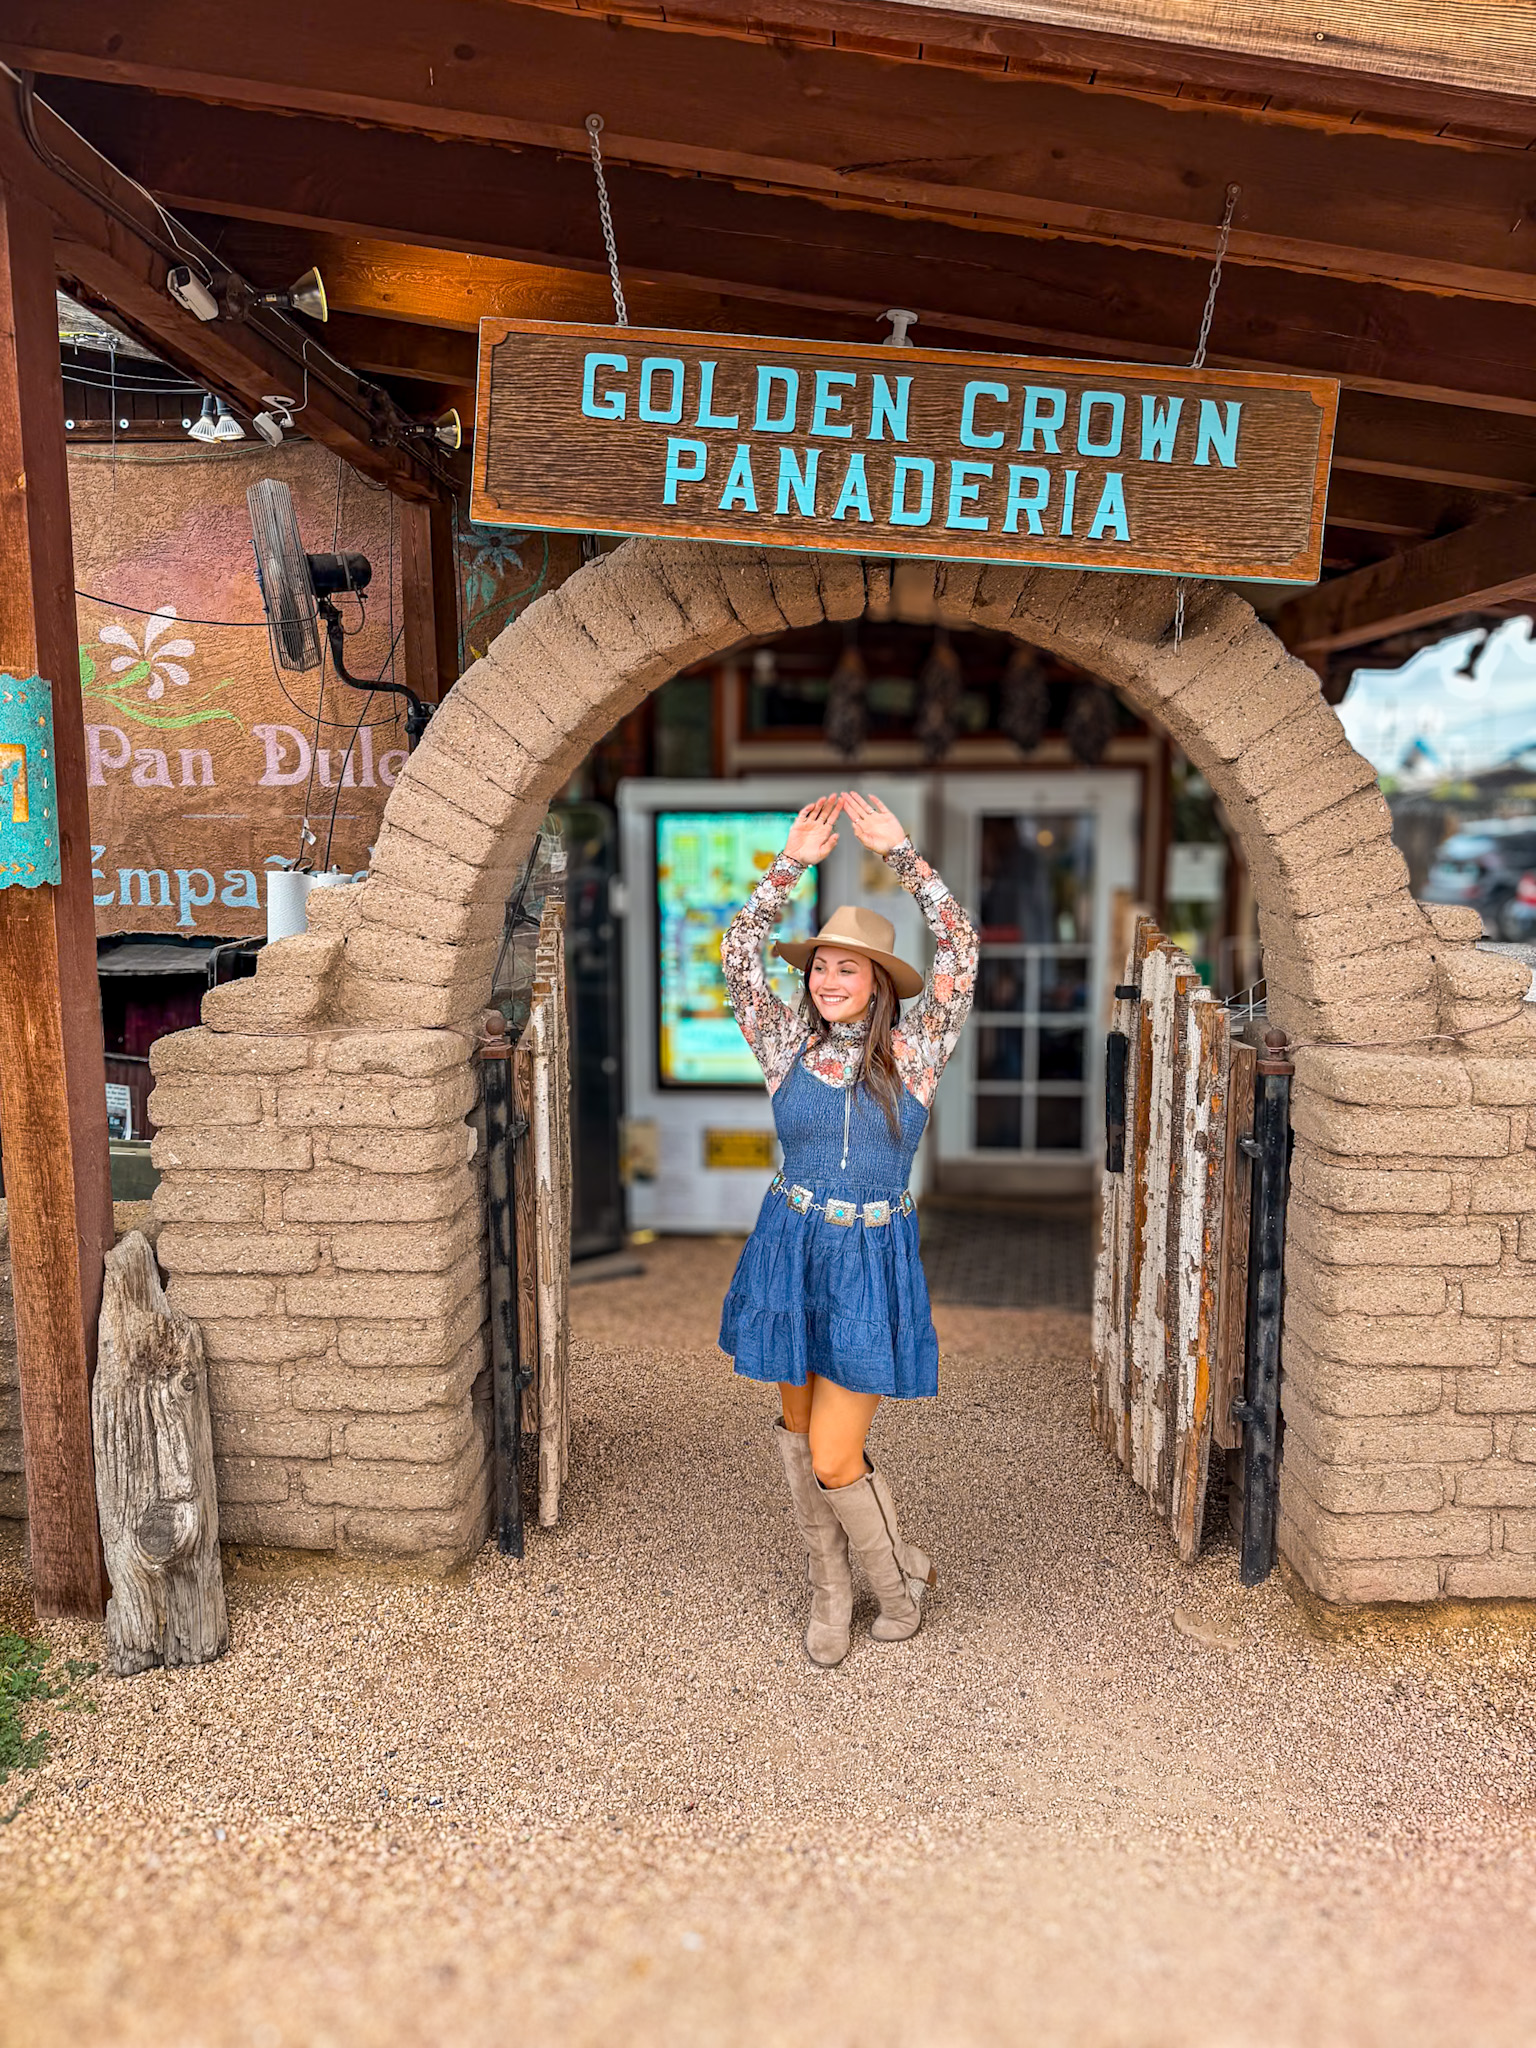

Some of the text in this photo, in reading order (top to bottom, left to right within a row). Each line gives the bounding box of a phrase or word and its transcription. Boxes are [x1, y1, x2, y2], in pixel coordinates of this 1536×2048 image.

[581, 352, 1243, 468] GOLDEN CROWN
[662, 436, 1131, 542] PANADERIA
[85, 724, 410, 788] Pan Dulc
